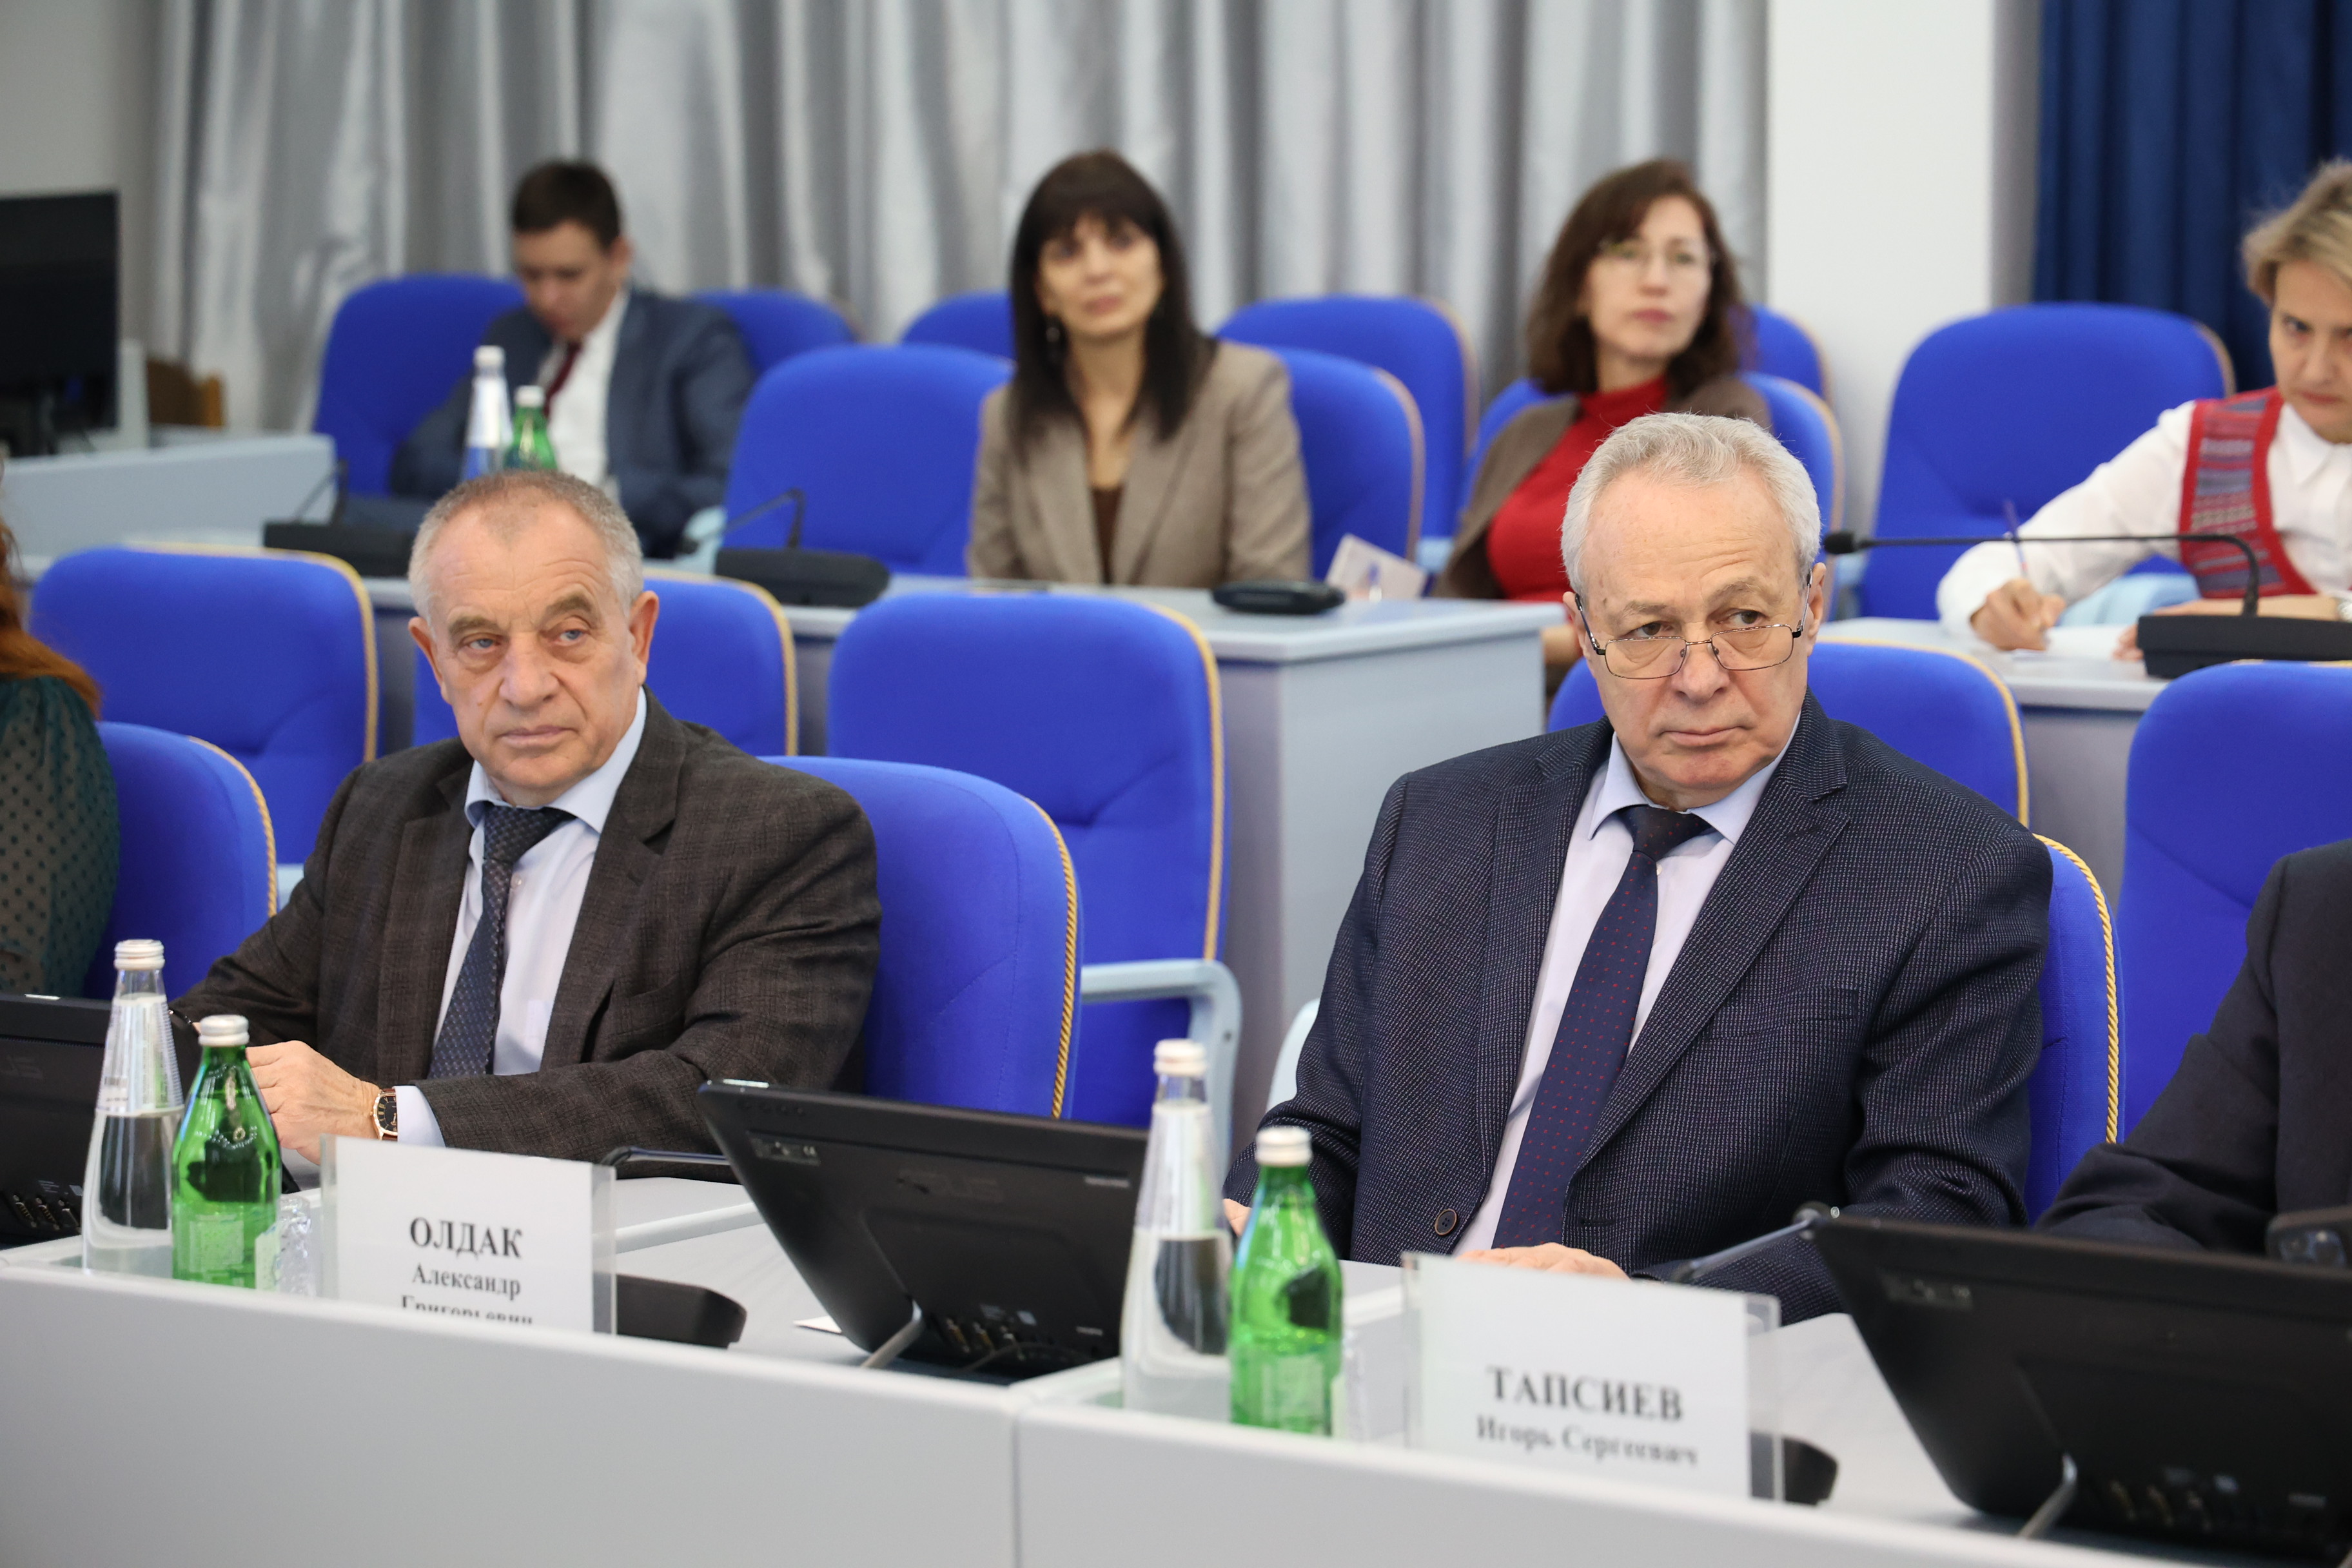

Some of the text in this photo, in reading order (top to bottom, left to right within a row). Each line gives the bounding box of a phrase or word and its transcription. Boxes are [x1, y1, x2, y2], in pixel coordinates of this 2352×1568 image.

[409, 1217, 523, 1259] ОЛДАК
[411, 1262, 521, 1301] Александр
[1486, 1365, 1685, 1422] ТАПСИЕВ
[1476, 1415, 1555, 1453] Игорь
